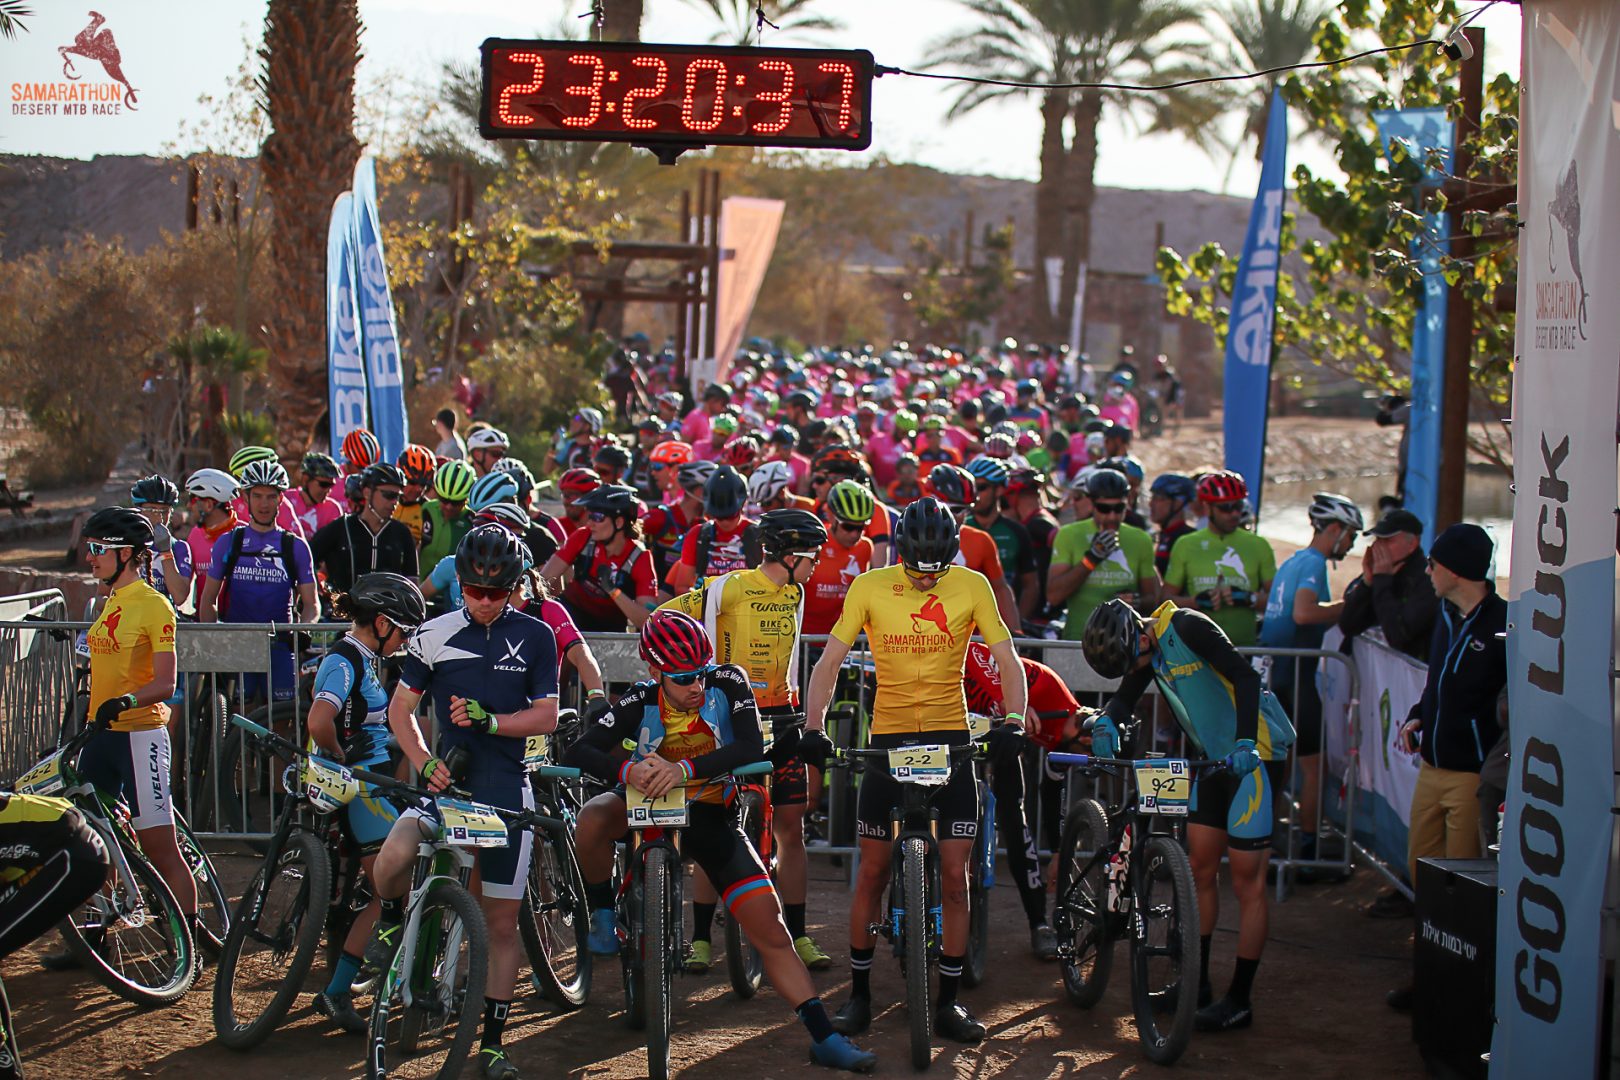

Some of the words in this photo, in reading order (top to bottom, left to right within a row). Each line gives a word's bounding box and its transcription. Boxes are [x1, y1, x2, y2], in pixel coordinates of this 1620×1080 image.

[499, 52, 854, 133] 23:20:37
[333, 286, 367, 438] Bike
[233, 566, 282, 578] SAMARATHON
[1528, 430, 1569, 695] LUCK
[883, 634, 947, 646] SAMARATHON
[911, 646, 926, 654] MTB
[928, 645, 947, 653] RACE
[619, 694, 639, 707] BIKE
[904, 754, 932, 766] 2-2
[149, 741, 163, 800] VELCAN
[1151, 778, 1176, 792] 9-2
[1515, 736, 1566, 1024] GOOD
[1422, 920, 1440, 944] אילת
